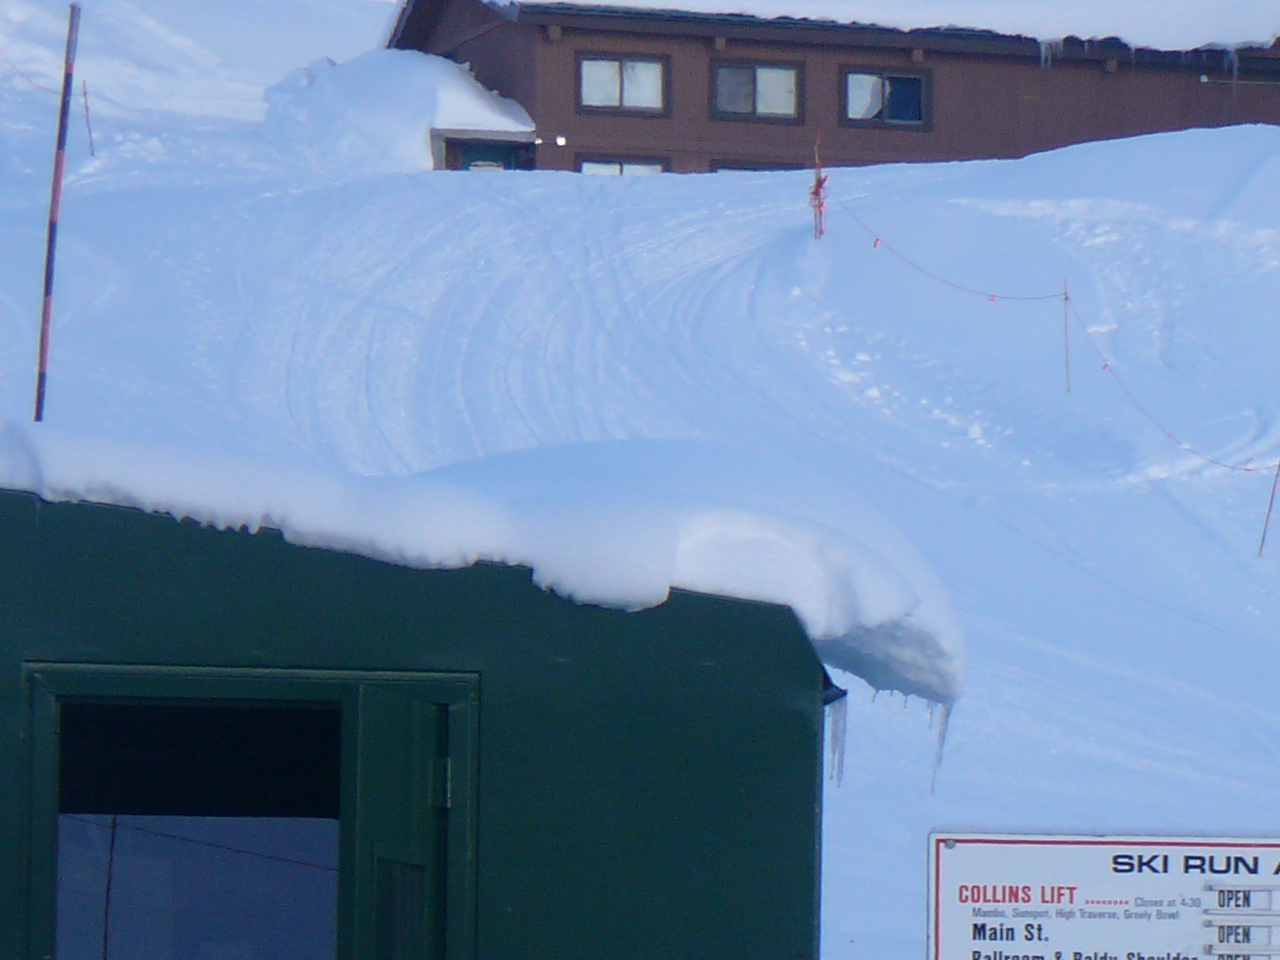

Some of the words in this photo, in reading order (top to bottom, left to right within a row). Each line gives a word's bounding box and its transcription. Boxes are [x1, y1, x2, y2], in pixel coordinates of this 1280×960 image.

[1112, 854, 1169, 874] SKI
[1183, 856, 1259, 874] RUN
[959, 885, 1031, 903] COLLINS
[1041, 886, 1077, 904] LIFT
[1218, 890, 1251, 908] OPEN
[972, 924, 1015, 941] Main
[1024, 924, 1049, 941] St.
[1218, 926, 1251, 943] OPEN
